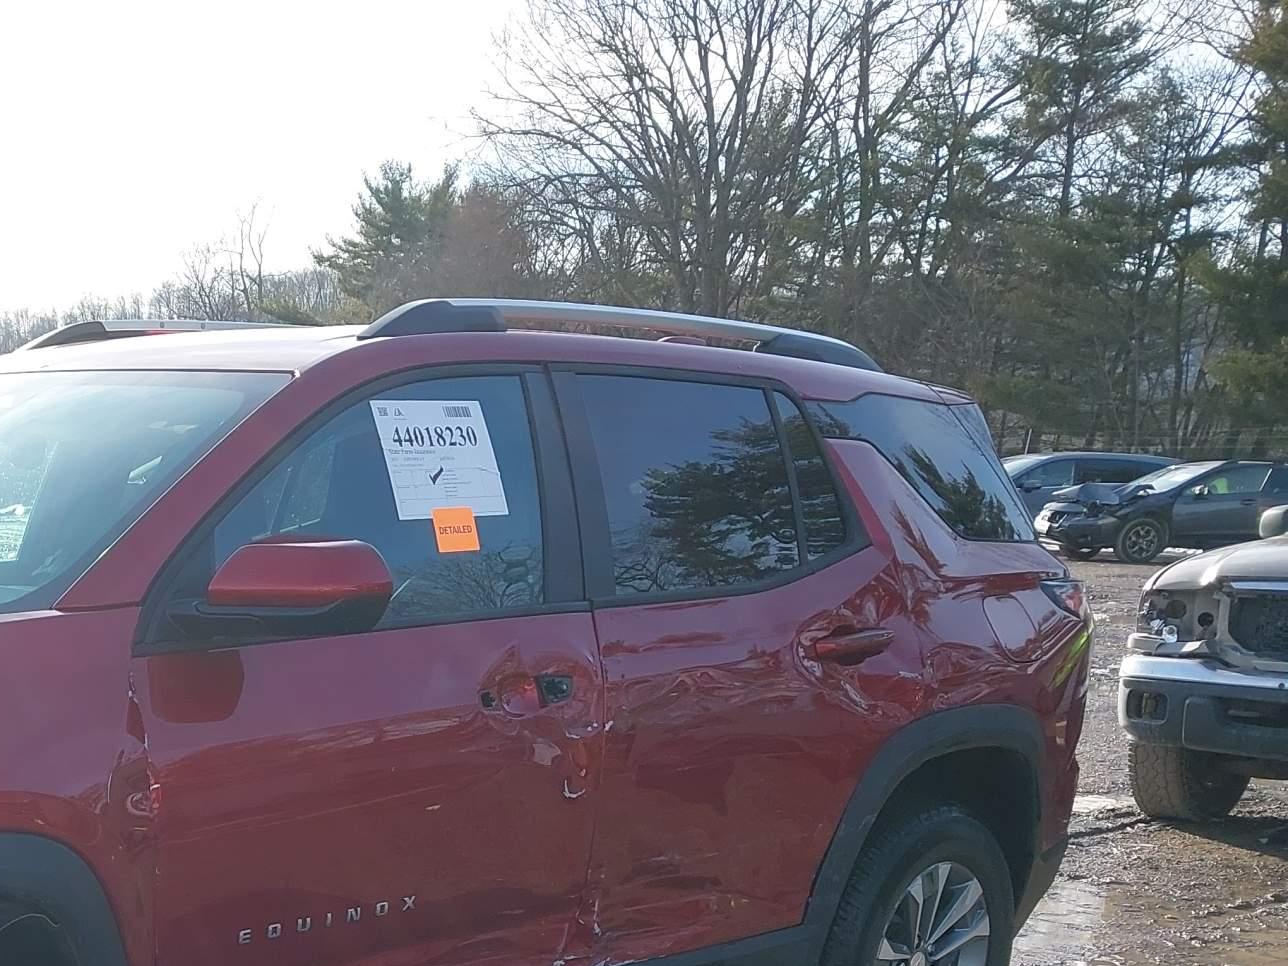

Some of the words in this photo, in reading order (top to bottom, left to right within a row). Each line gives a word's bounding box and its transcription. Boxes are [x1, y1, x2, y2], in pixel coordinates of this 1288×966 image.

[392, 425, 478, 447] 44018230
[438, 525, 473, 535] DETAILED
[238, 895, 416, 944] EQUINOX
